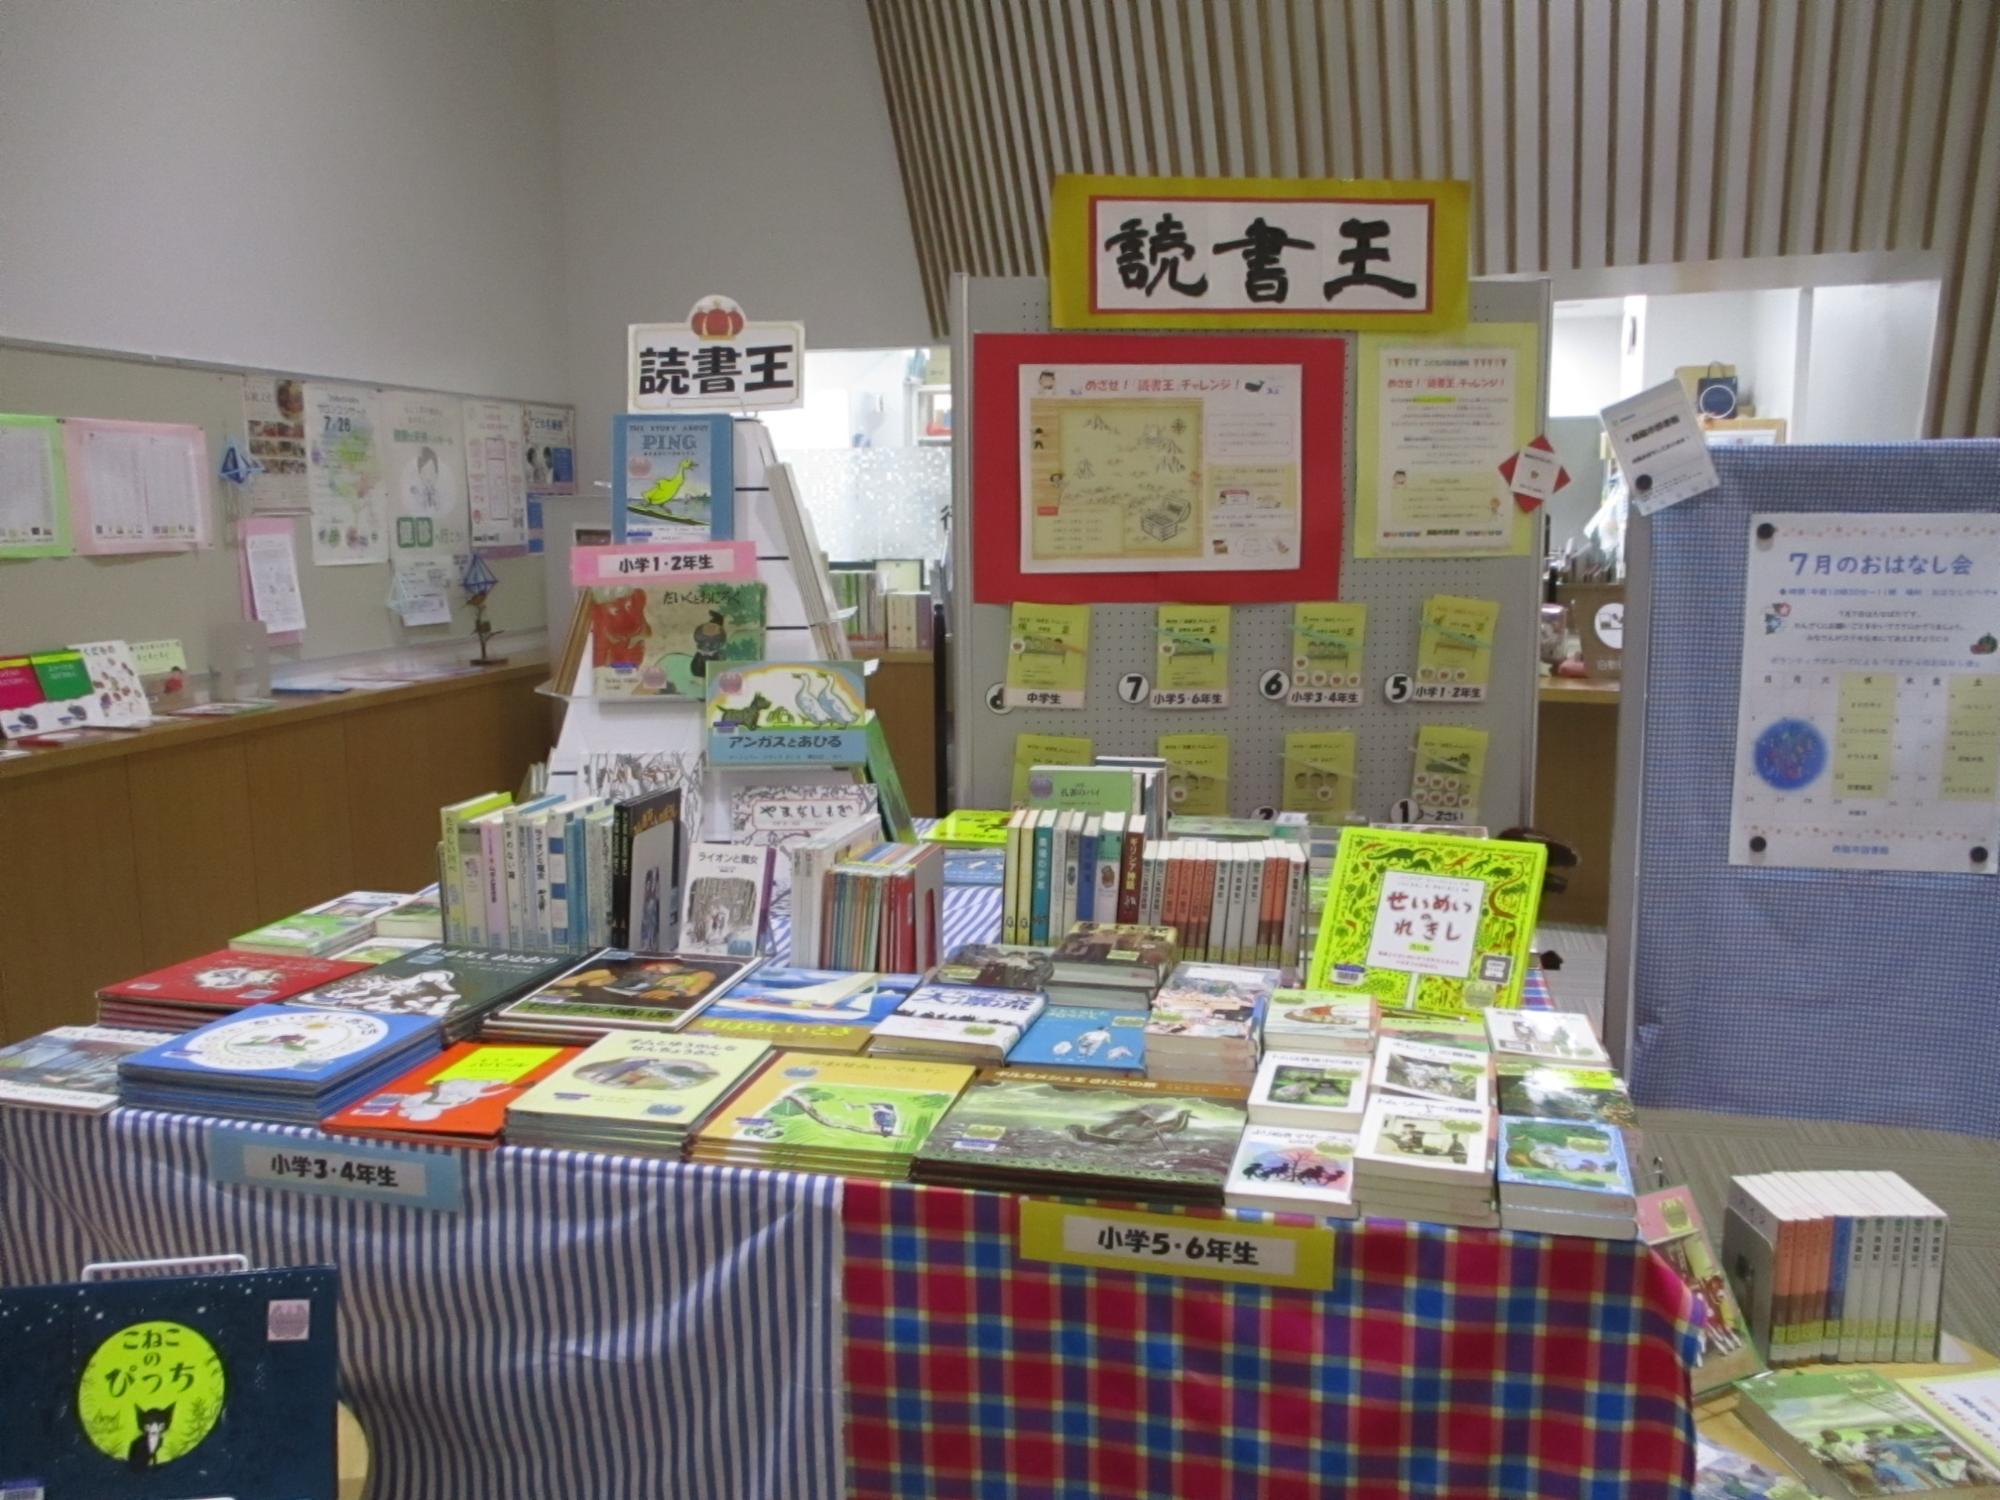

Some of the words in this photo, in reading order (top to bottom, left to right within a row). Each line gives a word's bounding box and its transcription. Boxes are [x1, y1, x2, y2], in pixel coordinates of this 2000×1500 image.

[1103, 212, 1417, 303] 読書王
[638, 344, 794, 396] 読書王
[642, 434, 697, 450] PING
[1126, 676, 1143, 701] 7
[1264, 671, 1283, 696] 6
[1392, 675, 1407, 699] 5
[1027, 692, 1062, 705] 中学生
[728, 735, 842, 749] アンガスとあひる
[1399, 799, 1409, 823] 1
[698, 852, 759, 865] ライオンと魔女
[1125, 837, 1139, 890] ギリシア神話
[1393, 918, 1462, 941] れきし
[123, 1328, 181, 1350] こねこ
[143, 1352, 161, 1366] の
[104, 1362, 196, 1399] ぴっち
